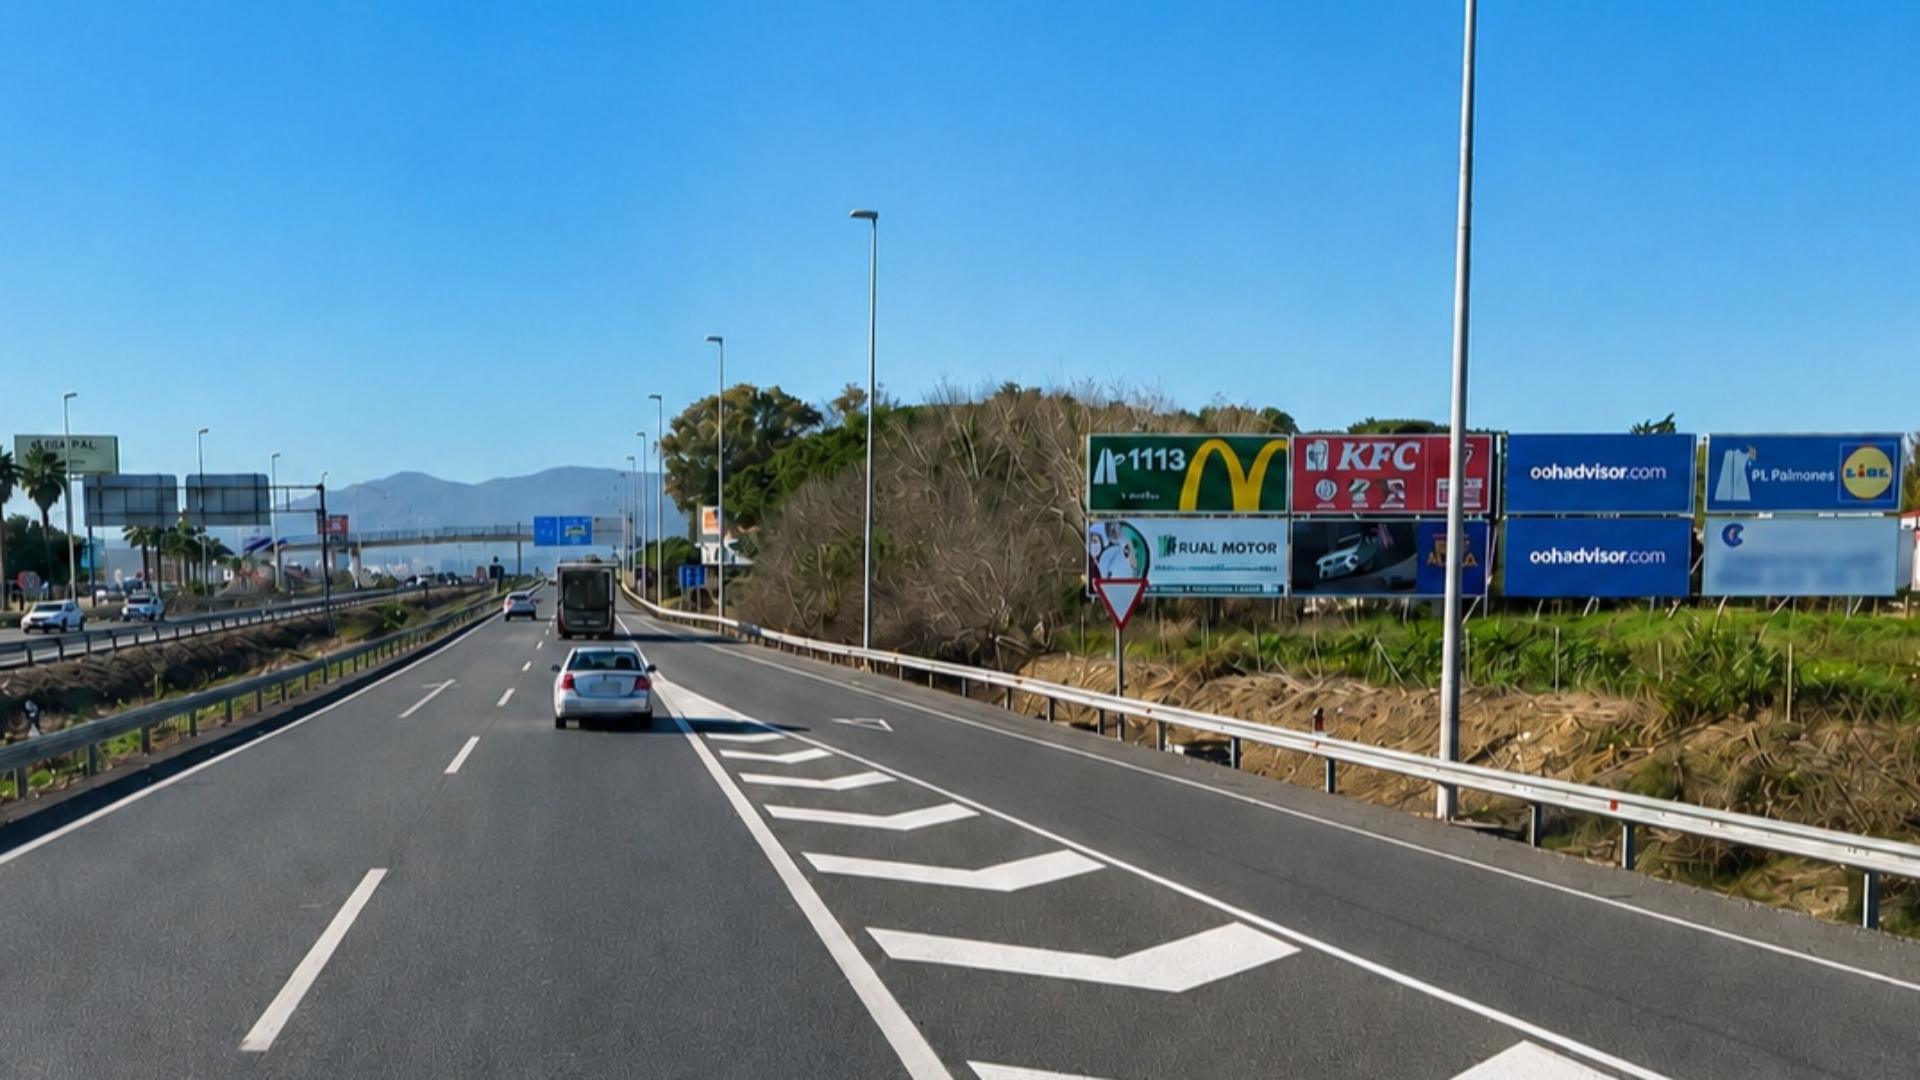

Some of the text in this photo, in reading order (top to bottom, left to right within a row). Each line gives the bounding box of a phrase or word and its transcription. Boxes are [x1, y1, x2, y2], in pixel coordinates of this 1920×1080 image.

[1128, 447, 1186, 471] 1113
[1336, 441, 1420, 471] KFC
[1530, 463, 1666, 480] oohadvisor.com
[1751, 468, 1835, 482] PL Palmones
[1179, 541, 1277, 554] RUAL MOTOR
[1529, 547, 1666, 564] oohadvisor.com
